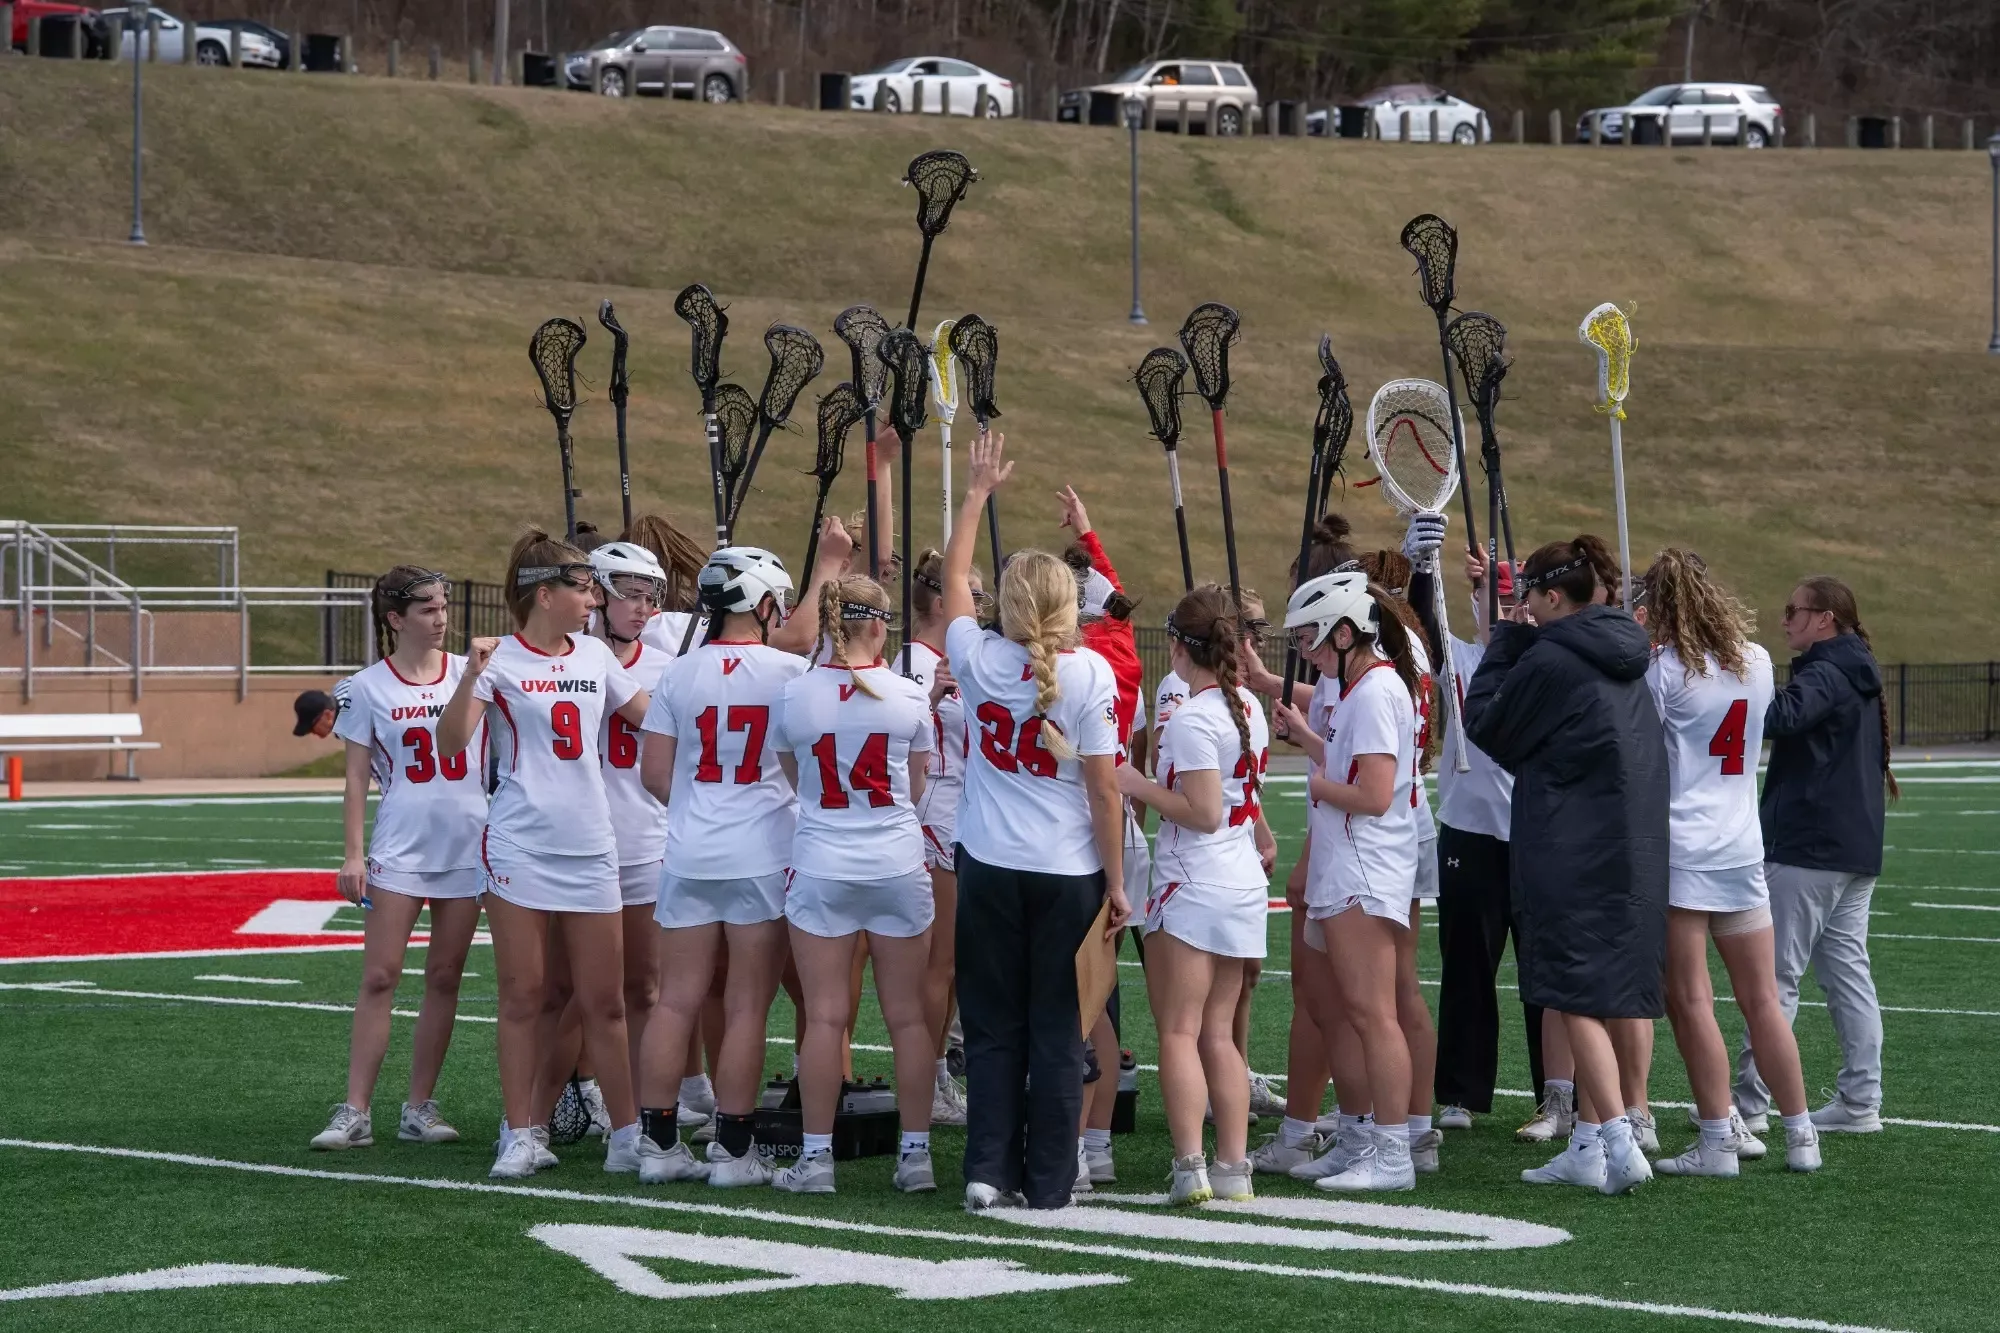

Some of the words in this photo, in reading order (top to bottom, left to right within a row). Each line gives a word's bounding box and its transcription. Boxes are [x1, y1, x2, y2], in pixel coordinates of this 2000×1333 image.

[622, 472, 630, 496] GAIT
[1545, 564, 1570, 580] STX
[848, 603, 867, 612] GAIT
[869, 608, 884, 617] GAIT
[1184, 635, 1203, 647] STX
[520, 679, 598, 694] UVAWISE
[391, 704, 447, 721] UVAW
[551, 700, 584, 760] 9
[600, 711, 639, 769] 6
[1708, 698, 1748, 776] 4
[694, 704, 770, 784] 17
[811, 732, 896, 810] 14
